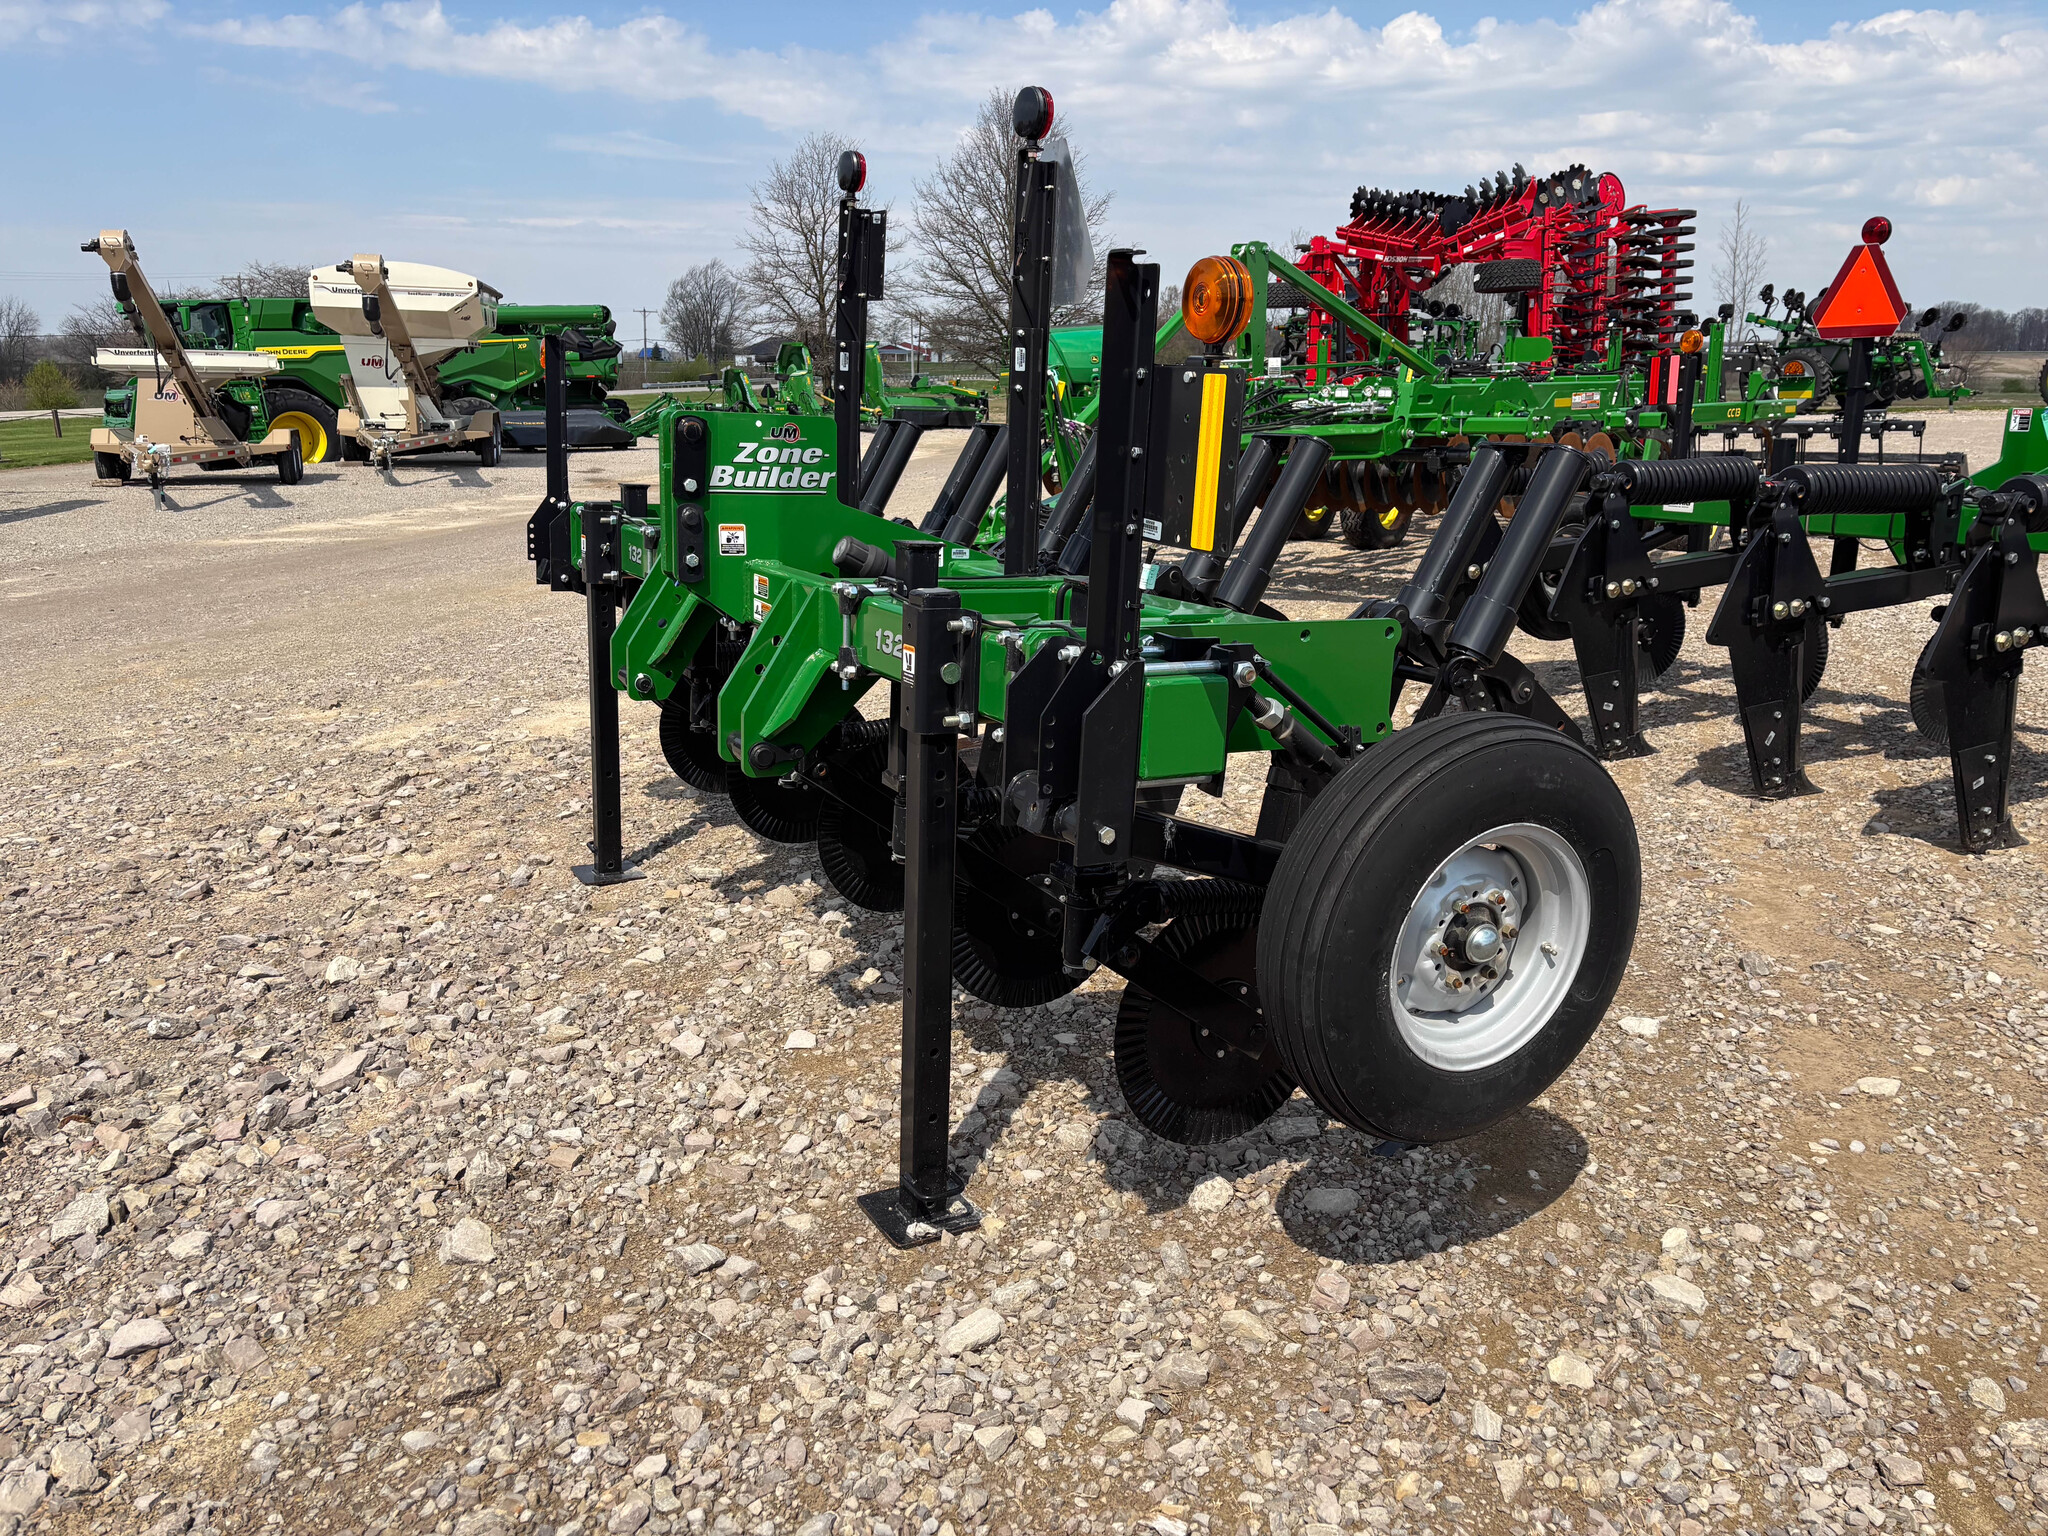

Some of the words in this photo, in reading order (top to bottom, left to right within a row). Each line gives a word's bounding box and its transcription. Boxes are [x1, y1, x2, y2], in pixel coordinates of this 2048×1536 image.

[332, 286, 362, 294] Unverfe
[770, 425, 799, 441] UM
[732, 442, 830, 464] Zone-
[709, 465, 837, 488] Builder
[628, 544, 643, 565] 132
[875, 628, 903, 659] 132
